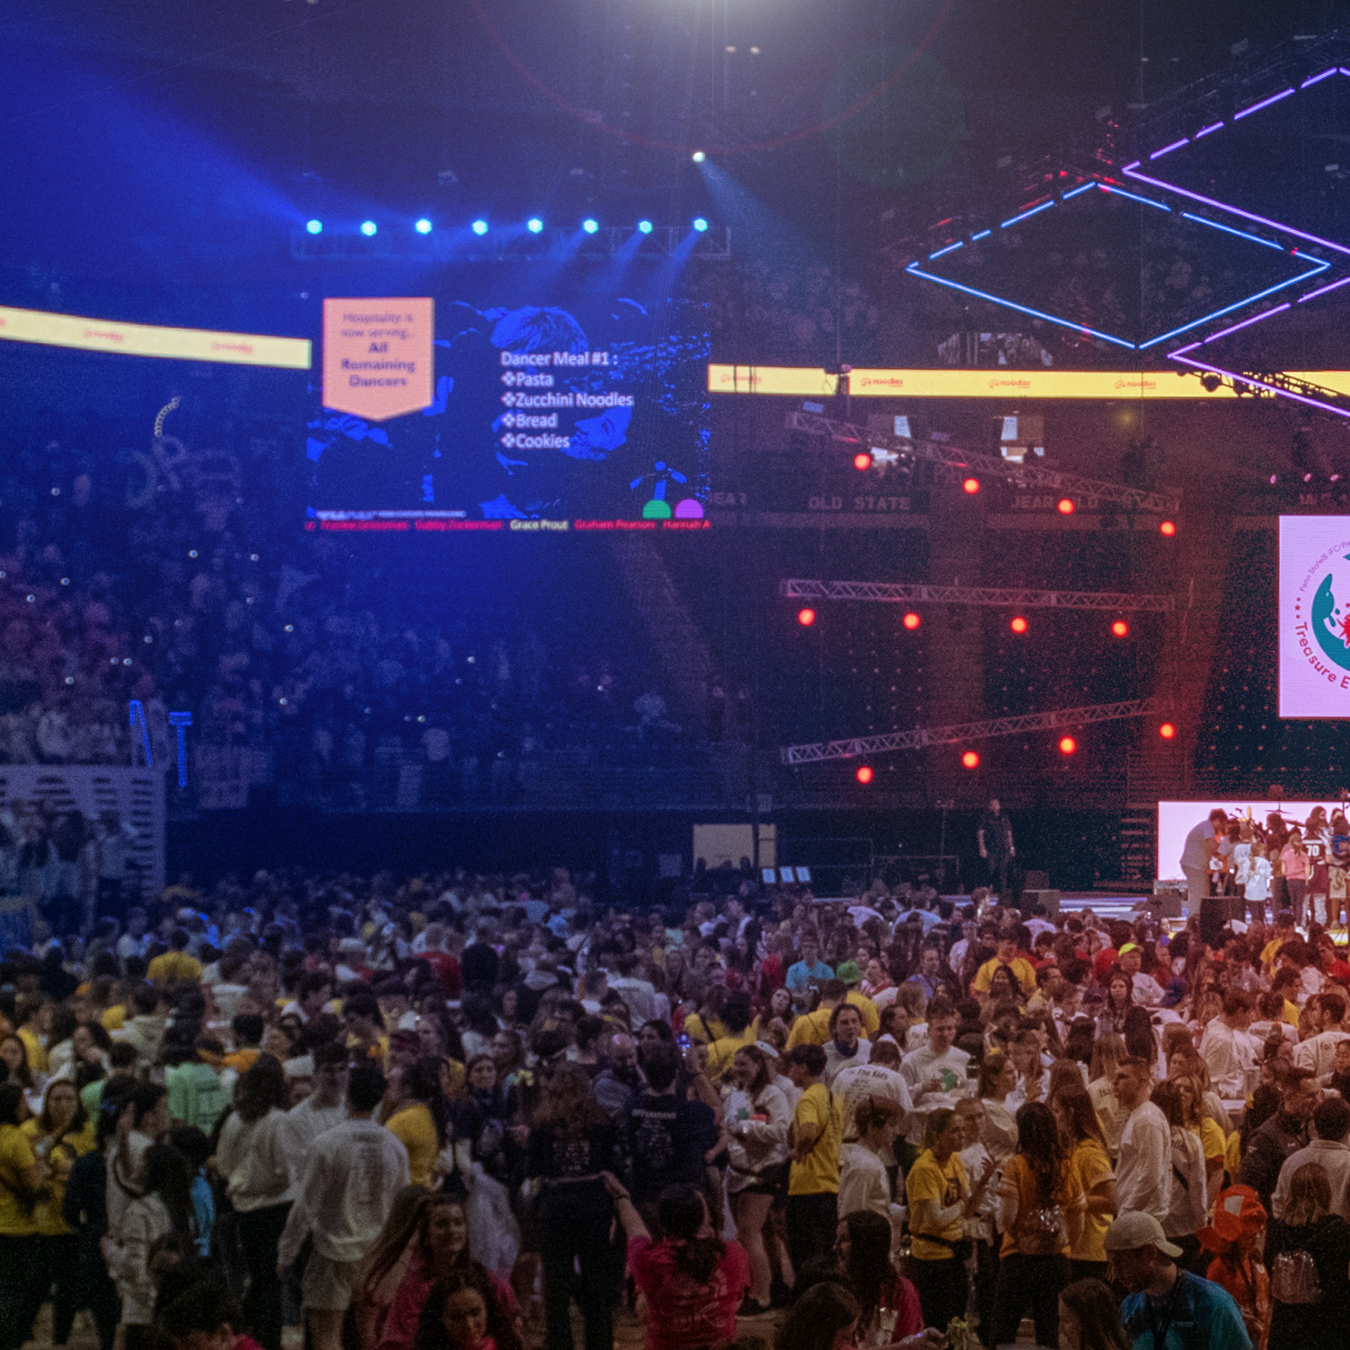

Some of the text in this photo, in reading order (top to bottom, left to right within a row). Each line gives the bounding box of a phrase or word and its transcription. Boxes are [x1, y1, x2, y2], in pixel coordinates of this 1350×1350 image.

[368, 342, 388, 353] All
[341, 358, 416, 373] Remaining
[500, 351, 551, 366] Dancer
[553, 351, 590, 366] Meal
[592, 351, 608, 366] #1
[349, 374, 408, 388] Dancers
[516, 372, 554, 388] Pasta
[516, 392, 634, 407] Zucchini Noodles
[516, 413, 558, 428] Bread
[516, 434, 570, 449] Cookies
[854, 496, 911, 510] STATE
[510, 520, 538, 530] Grace
[540, 520, 568, 530] Prout
[1295, 621, 1337, 682] Treasure
[1306, 845, 1320, 856] 70
